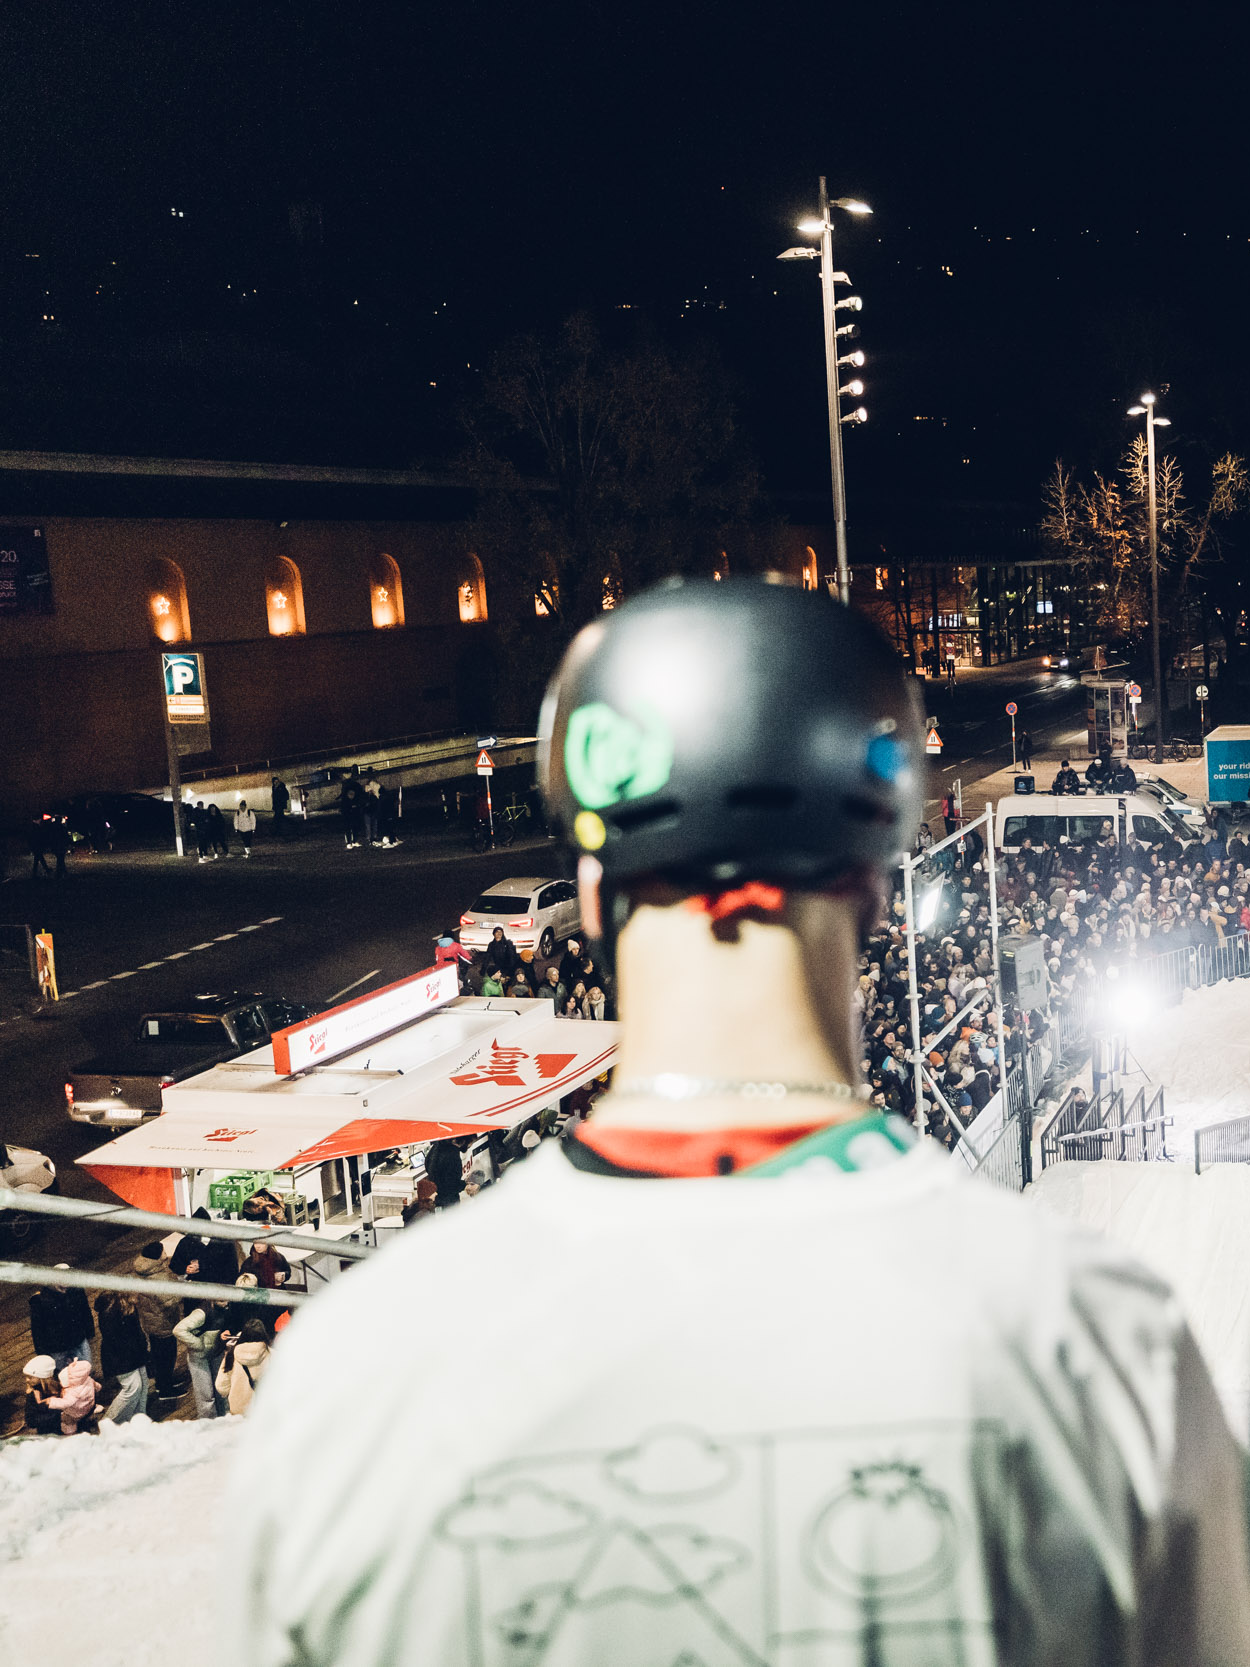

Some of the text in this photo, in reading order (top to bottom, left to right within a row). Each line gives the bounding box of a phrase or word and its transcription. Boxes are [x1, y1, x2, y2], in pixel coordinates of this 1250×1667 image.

[172, 664, 194, 693] P
[309, 1028, 328, 1052] Stiegl
[449, 1038, 530, 1086] Stiegl
[203, 1128, 259, 1139] Stiegl
